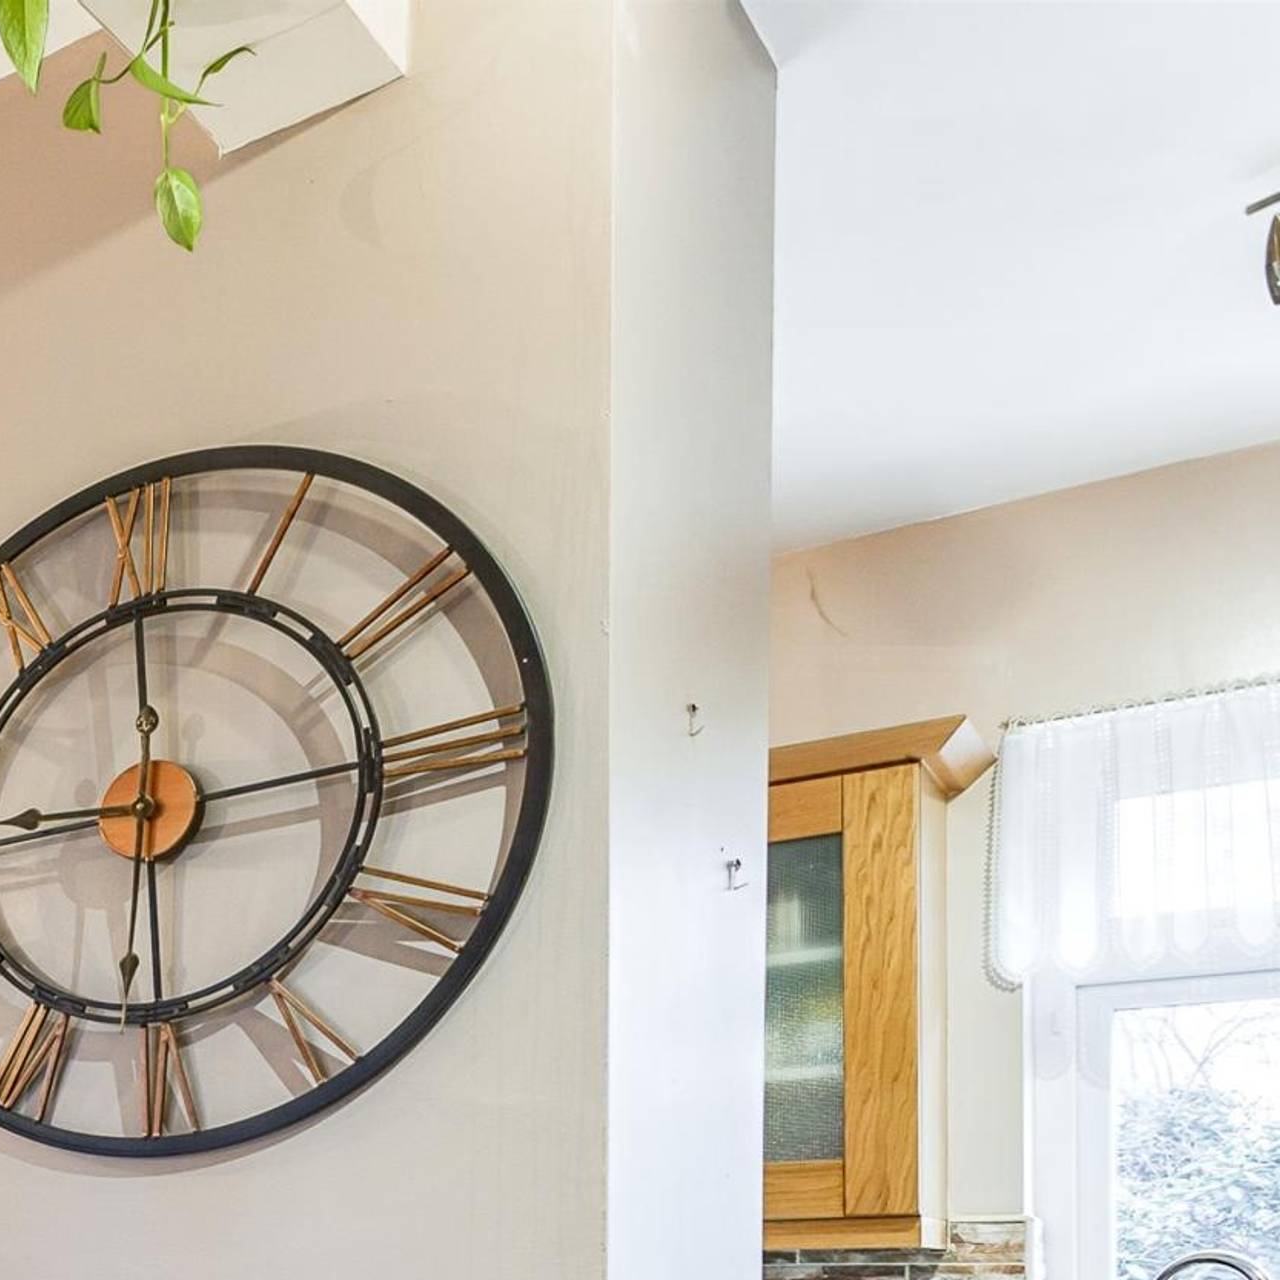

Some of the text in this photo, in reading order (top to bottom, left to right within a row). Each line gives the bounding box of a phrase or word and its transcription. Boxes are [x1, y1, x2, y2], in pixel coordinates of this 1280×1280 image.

[105, 476, 172, 607] XII
[335, 546, 473, 661] II
[378, 703, 528, 777] III
[348, 864, 492, 953] IV
[141, 1022, 200, 1138] VI
[270, 978, 364, 1084] V
